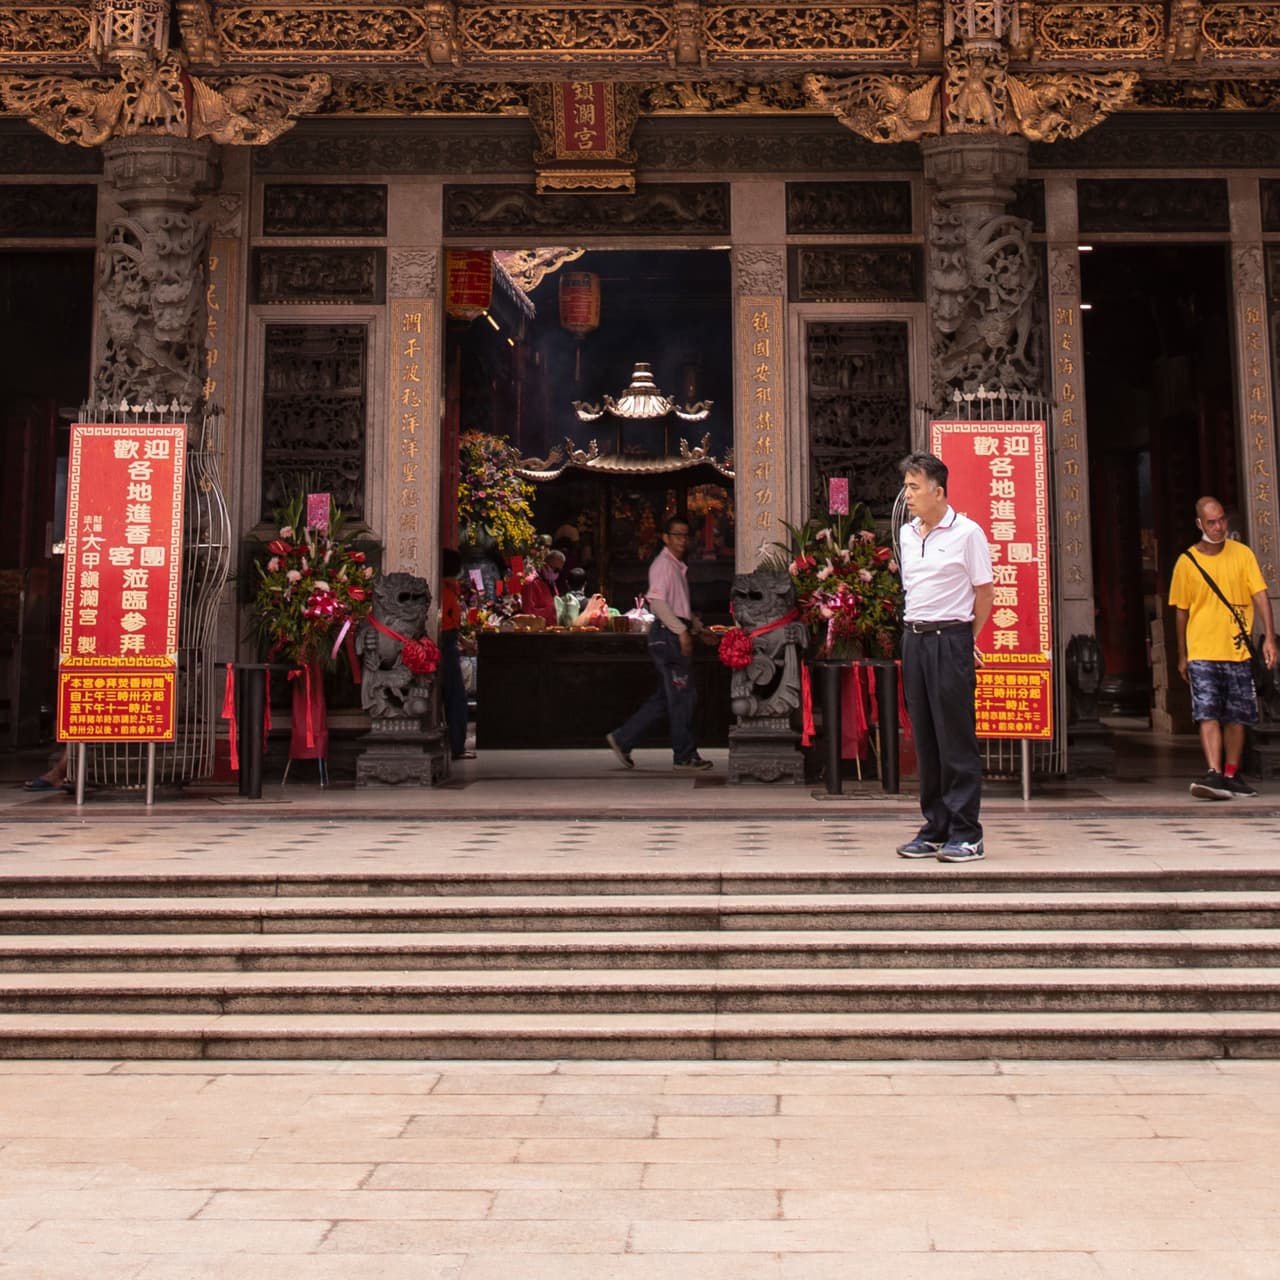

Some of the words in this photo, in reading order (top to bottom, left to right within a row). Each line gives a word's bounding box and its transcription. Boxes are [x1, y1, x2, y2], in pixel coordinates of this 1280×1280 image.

[570, 81, 598, 150] 鎮瀾宮
[113, 439, 170, 460] 歡迎
[973, 437, 1030, 458] 歡迎
[79, 535, 106, 626] 大甲鎮瀾宮
